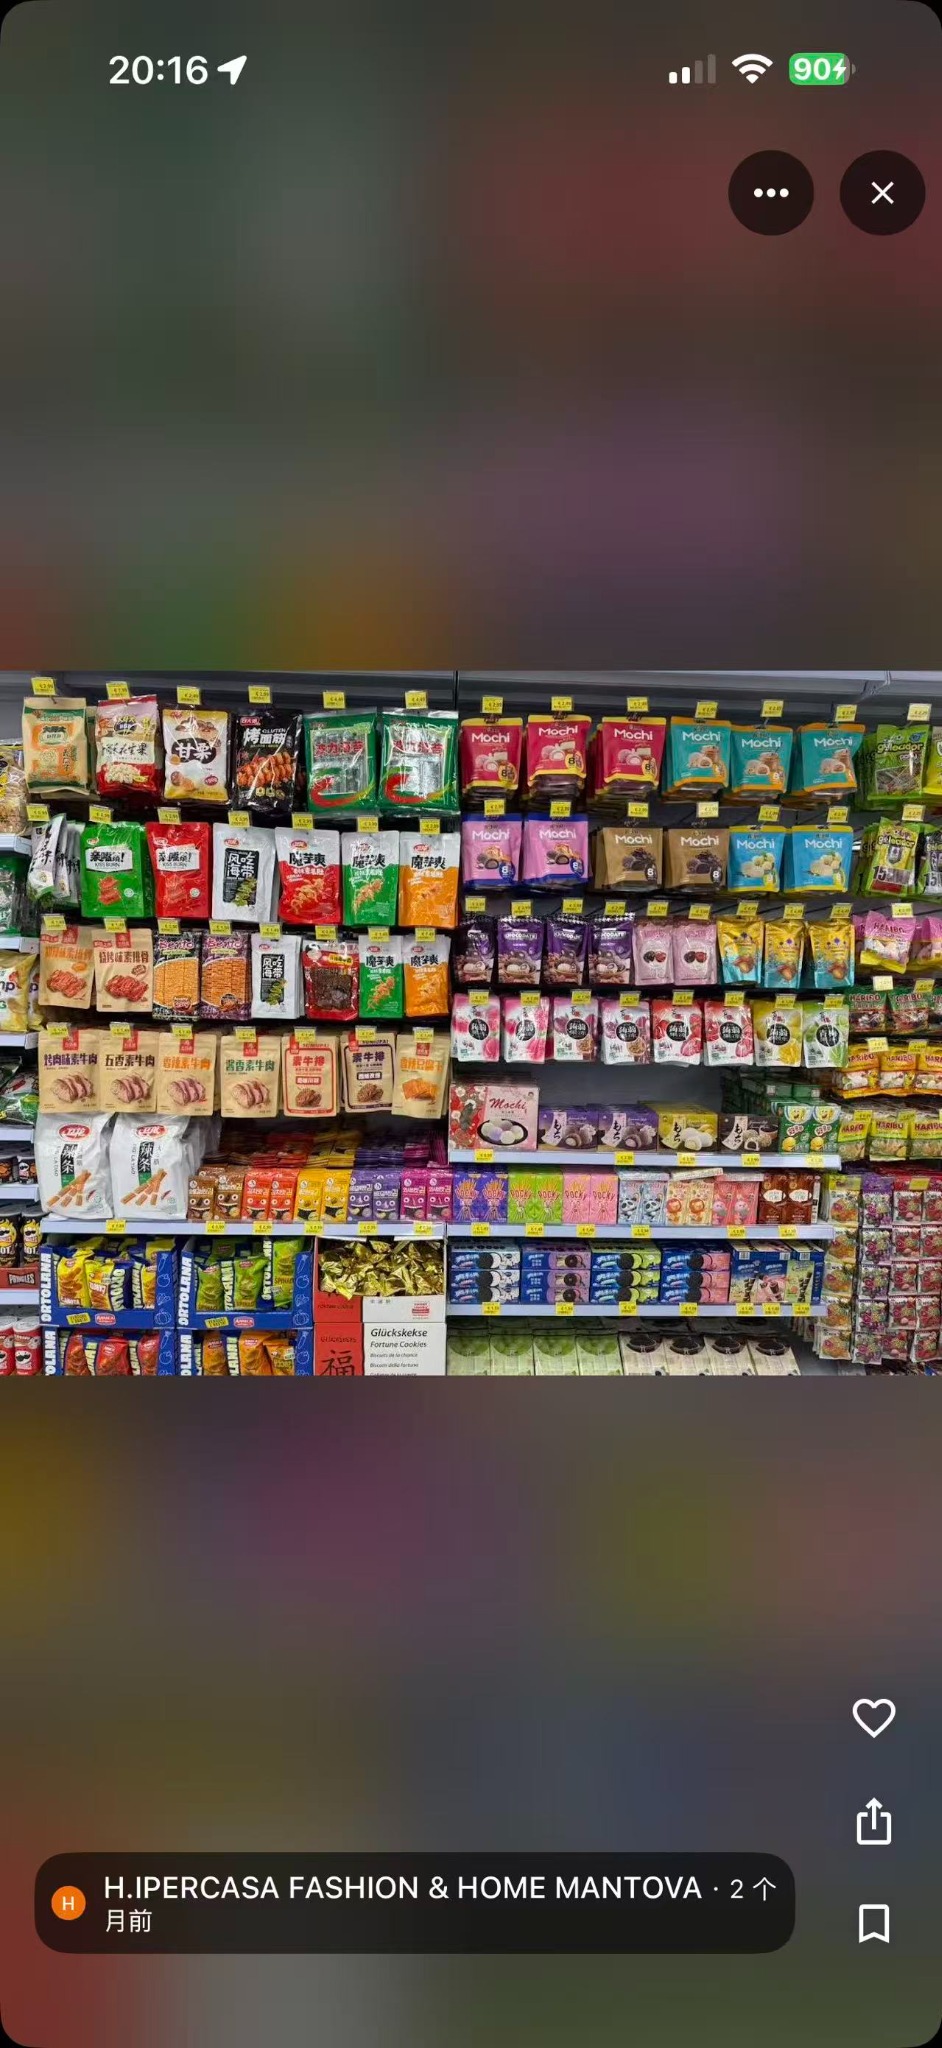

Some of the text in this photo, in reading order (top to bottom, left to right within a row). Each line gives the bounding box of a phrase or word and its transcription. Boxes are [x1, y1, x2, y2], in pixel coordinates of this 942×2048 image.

[538, 726, 578, 736] Mochi
[614, 728, 653, 740] Mochi
[682, 731, 721, 742] Mochi
[471, 732, 510, 743] Mochi
[741, 737, 782, 748] Mochi
[813, 736, 853, 747] Mochi
[175, 742, 212, 760] 甘栗
[471, 830, 511, 840] Mochi
[538, 828, 577, 840] Mochi
[615, 834, 653, 844] Mochi
[680, 835, 720, 846] Mochi
[736, 838, 775, 849] Mochi
[804, 838, 843, 849] Mochi
[105, 1054, 155, 1067] 五香素牛肉
[489, 1097, 527, 1110] Mochi
[40, 1253, 52, 1322] ORTOLANA
[178, 1256, 192, 1326] ORTOLANA
[370, 1328, 428, 1338] Glückskekse
